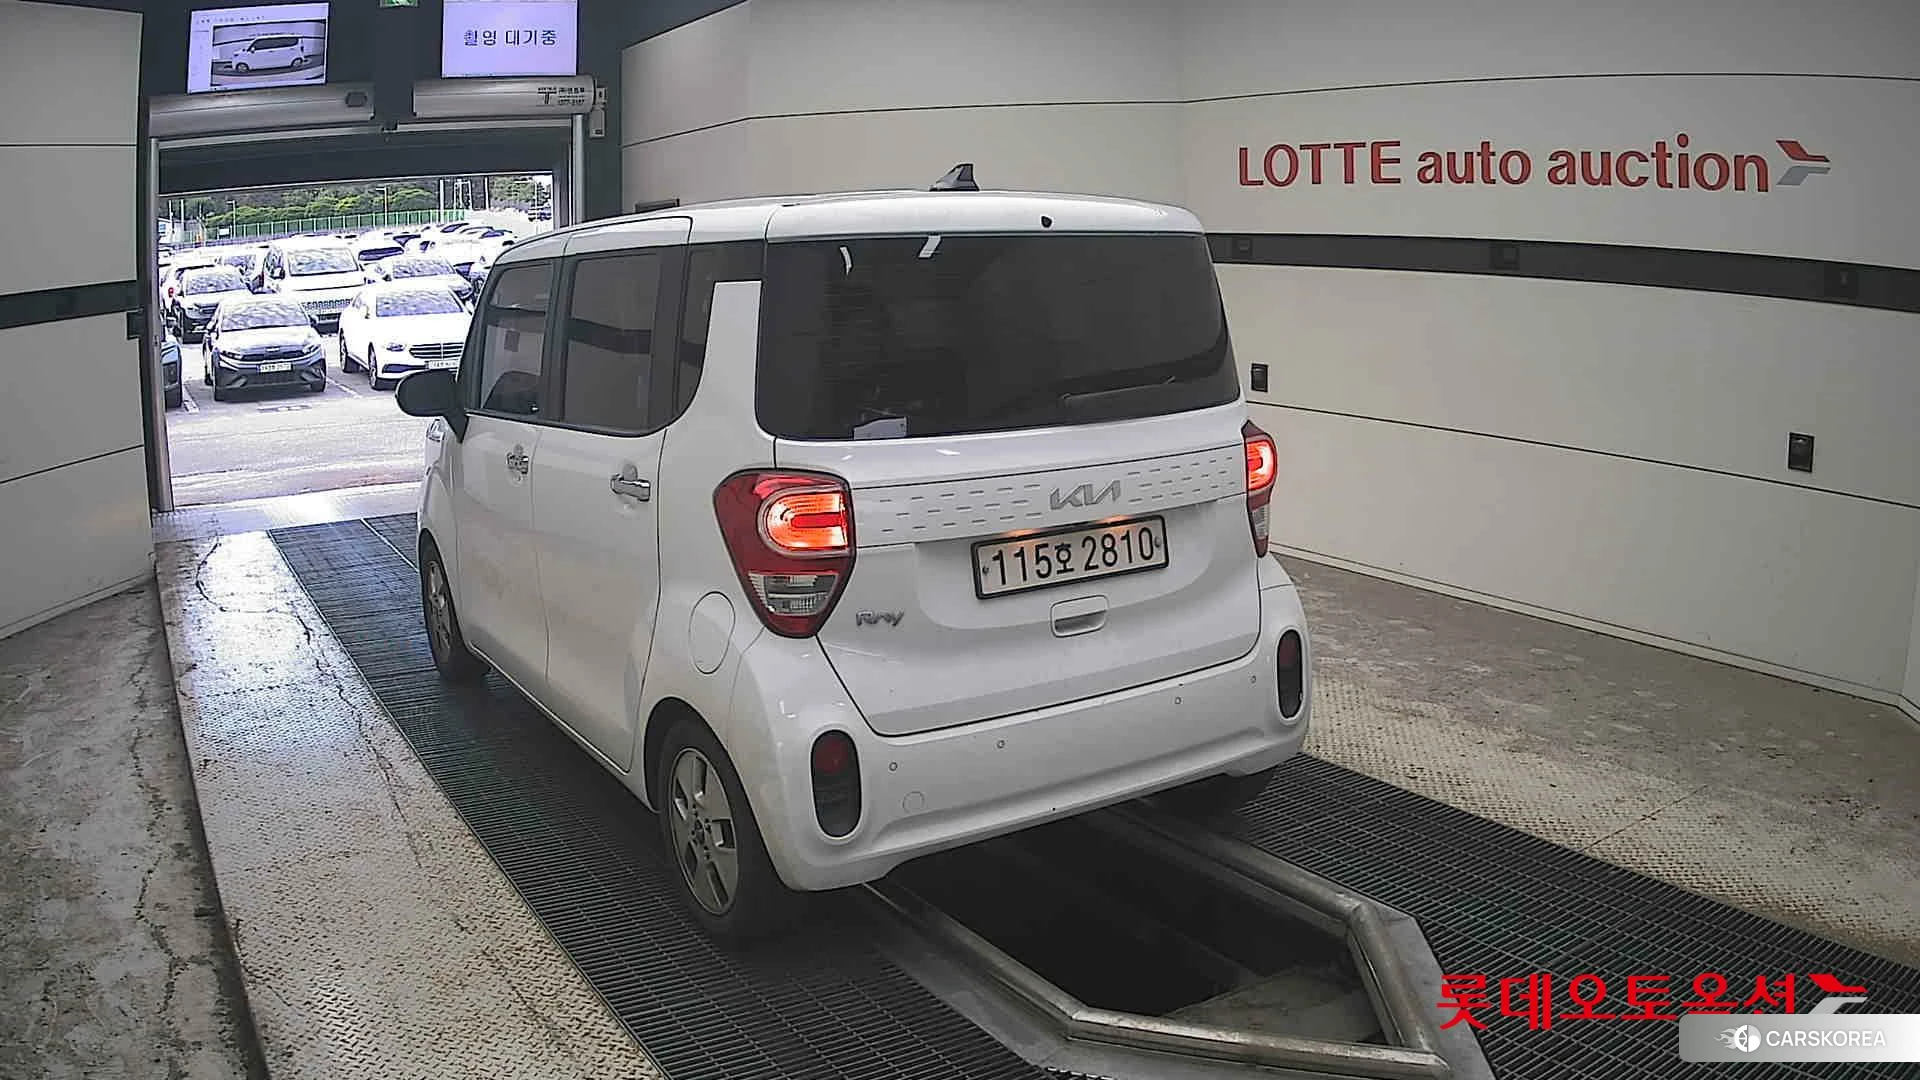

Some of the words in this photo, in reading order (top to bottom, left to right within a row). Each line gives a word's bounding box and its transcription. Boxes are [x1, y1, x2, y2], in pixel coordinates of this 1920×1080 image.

[505, 29, 557, 46] 대기중
[1239, 141, 1400, 187] LOTTE
[1417, 141, 1531, 185] auto
[1547, 133, 1769, 192] auction
[991, 542, 1075, 586] 115호
[1081, 525, 1154, 572] 2810
